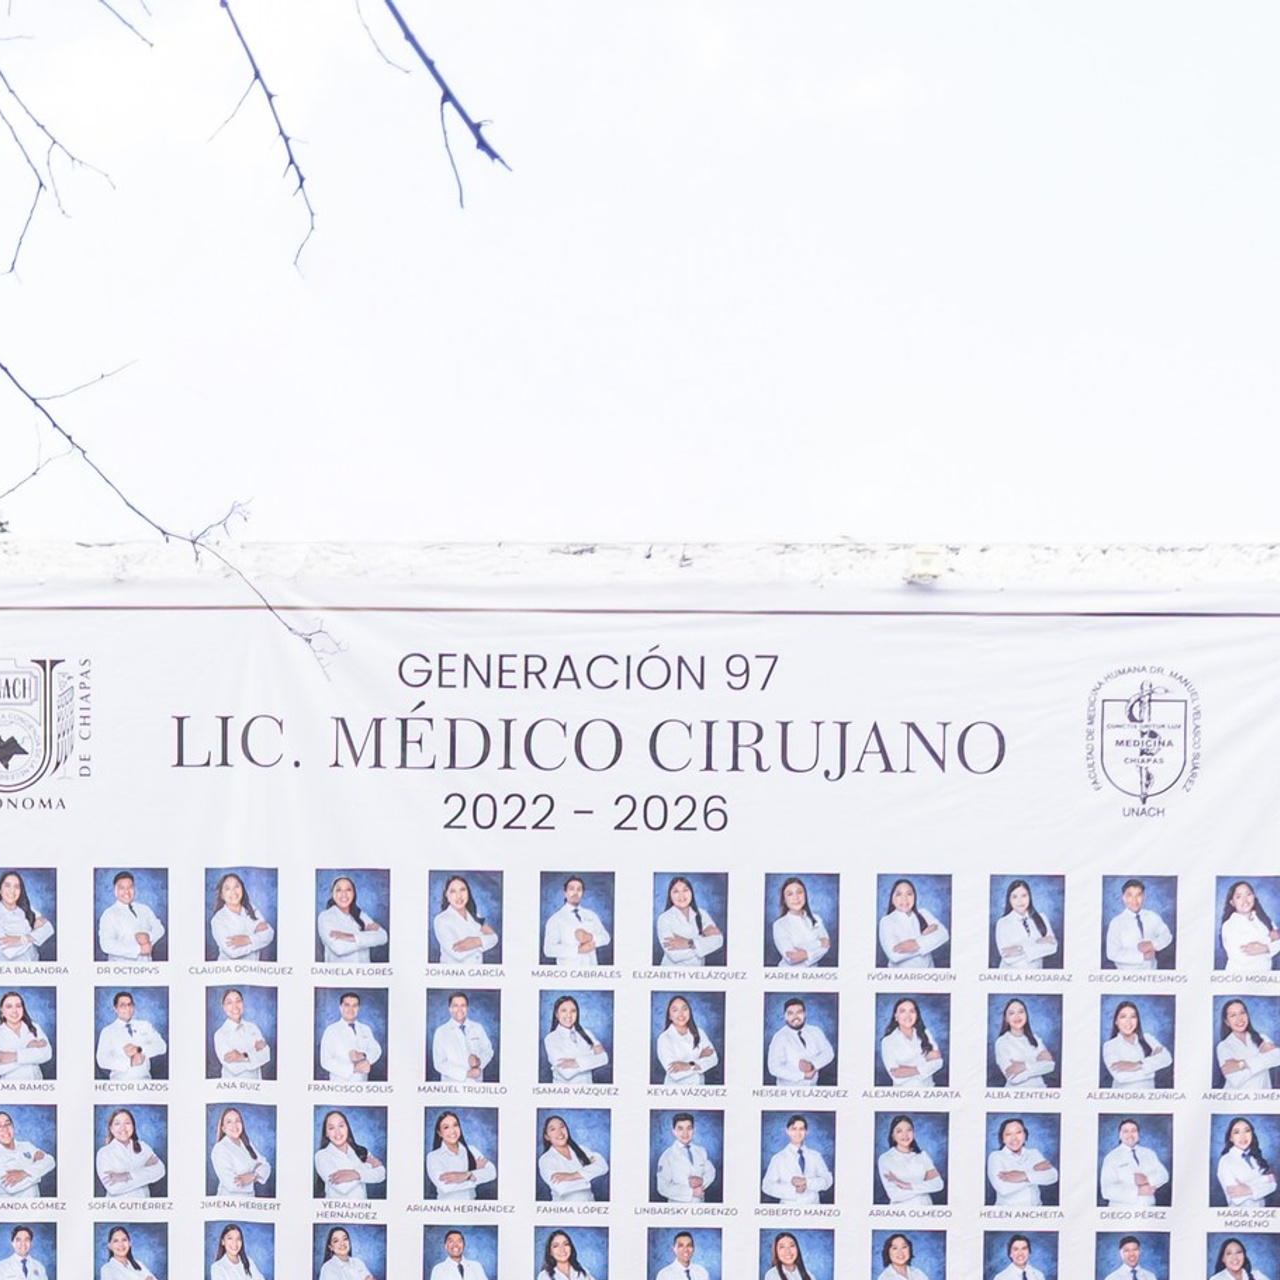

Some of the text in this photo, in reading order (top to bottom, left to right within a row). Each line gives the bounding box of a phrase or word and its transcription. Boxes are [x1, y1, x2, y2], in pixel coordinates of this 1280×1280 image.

[398, 644, 778, 691] GENERACIÓN 97
[1103, 666, 1147, 683] HUMANA
[79, 659, 91, 777] DE CHIAPAS
[171, 700, 1006, 782] LIC. MÉDICO CIRUJANO
[1114, 739, 1174, 748] MEDICINA
[1123, 757, 1165, 765] CHIAPAS
[443, 793, 555, 830] 2022
[613, 794, 728, 832] 2026
[1122, 807, 1165, 818] UNACH
[311, 967, 393, 976] DANIELA FLORES
[802, 972, 837, 980] RAMOS
[1025, 974, 1072, 982] MOJARAZ
[95, 1083, 169, 1091] HÉCTOR LAZOS
[308, 1084, 363, 1093] FRANCISCO
[418, 1085, 507, 1094] MANUEL TRUJILLO
[681, 1088, 727, 1097] VÁZQUEZ
[985, 1091, 1060, 1099] ALBA ZENTENO
[31, 1201, 66, 1210] GÓMEZ
[406, 1204, 515, 1213] ARIANNA HERNÁNDEZ
[754, 1208, 840, 1217] ROBERTO MANZO
[1100, 1211, 1166, 1219] DIEGO PÉREZ
